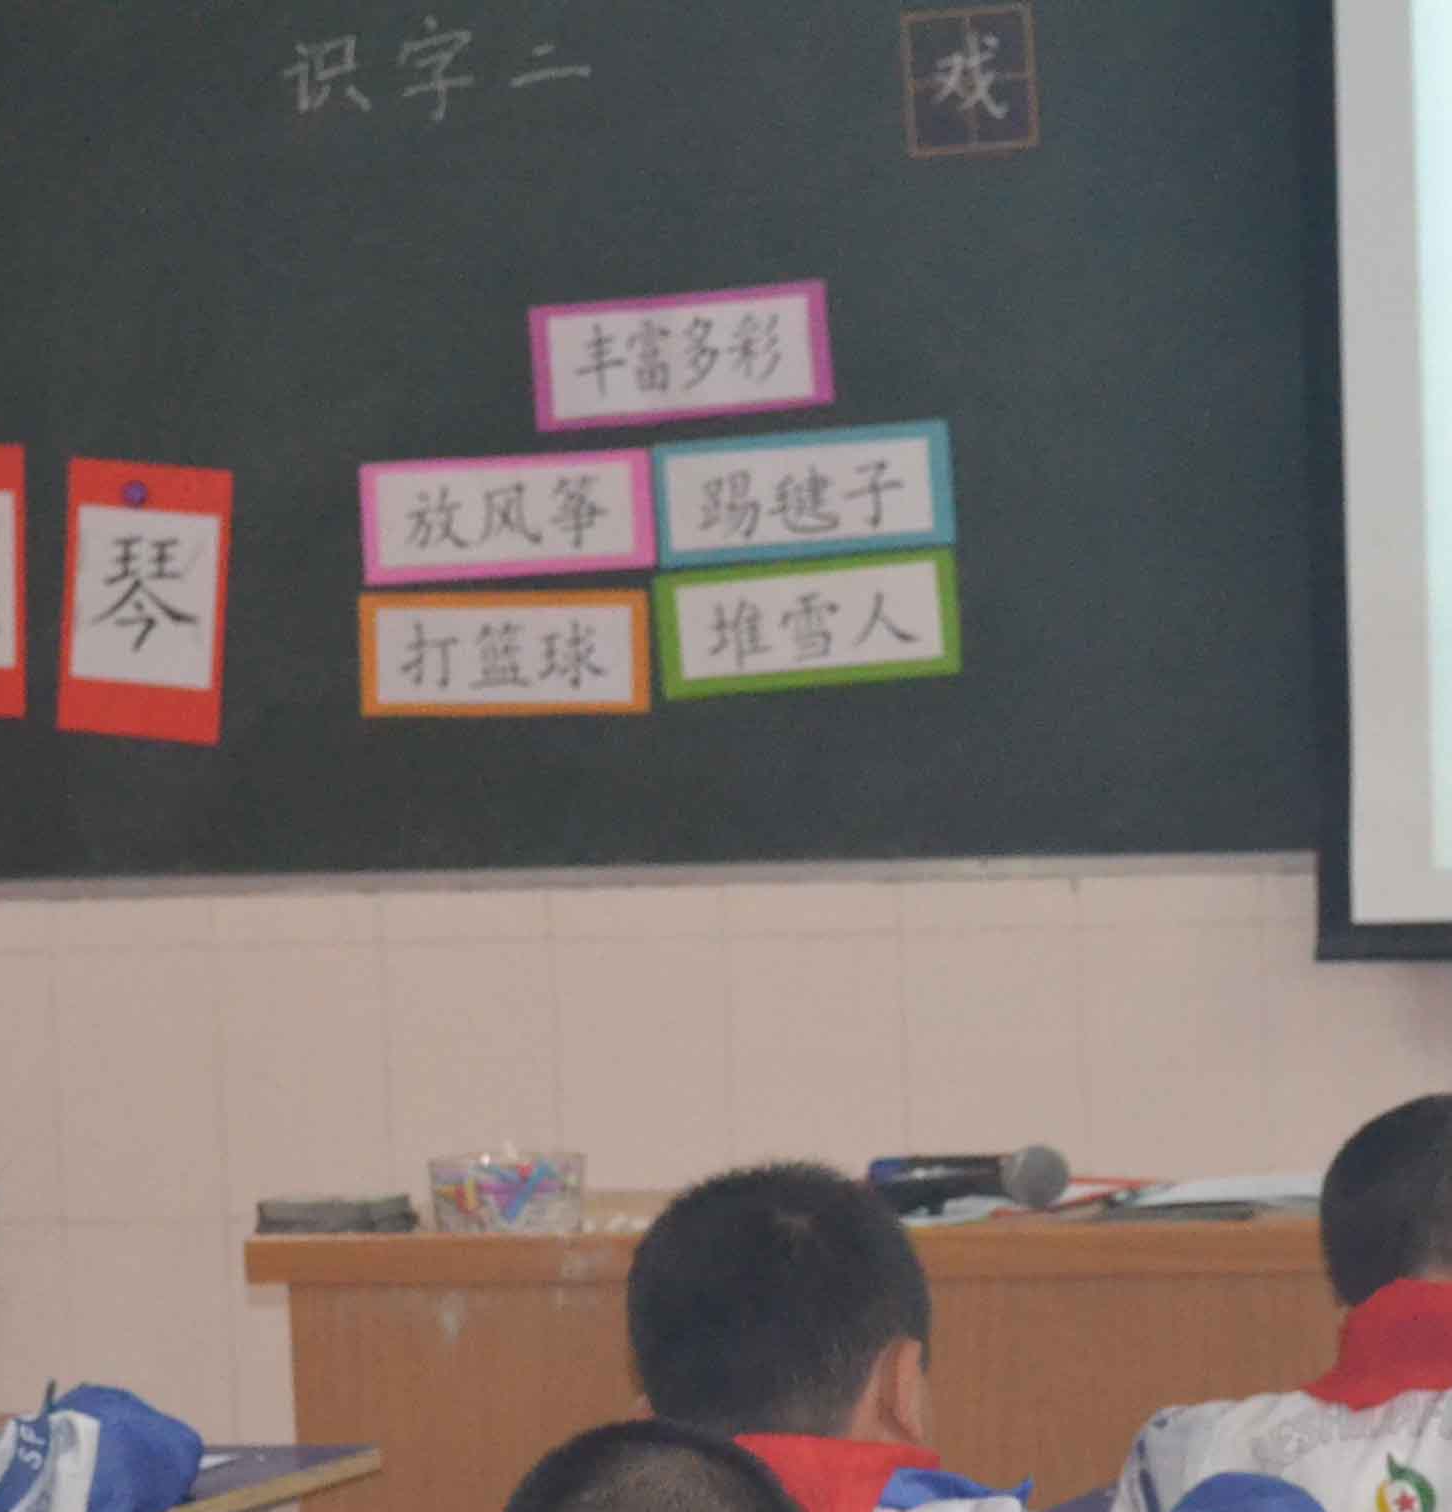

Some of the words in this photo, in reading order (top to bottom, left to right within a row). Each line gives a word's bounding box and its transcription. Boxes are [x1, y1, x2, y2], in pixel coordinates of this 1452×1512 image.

[283, 15, 591, 121] 识字二
[934, 31, 1009, 119] 戏
[575, 313, 782, 395] 丰富多彩
[405, 475, 608, 551] 放风筝
[699, 460, 905, 539] 踢毽子
[90, 534, 200, 653] 琴
[708, 589, 923, 668] 堆雪人
[400, 619, 609, 690] 打篮球
